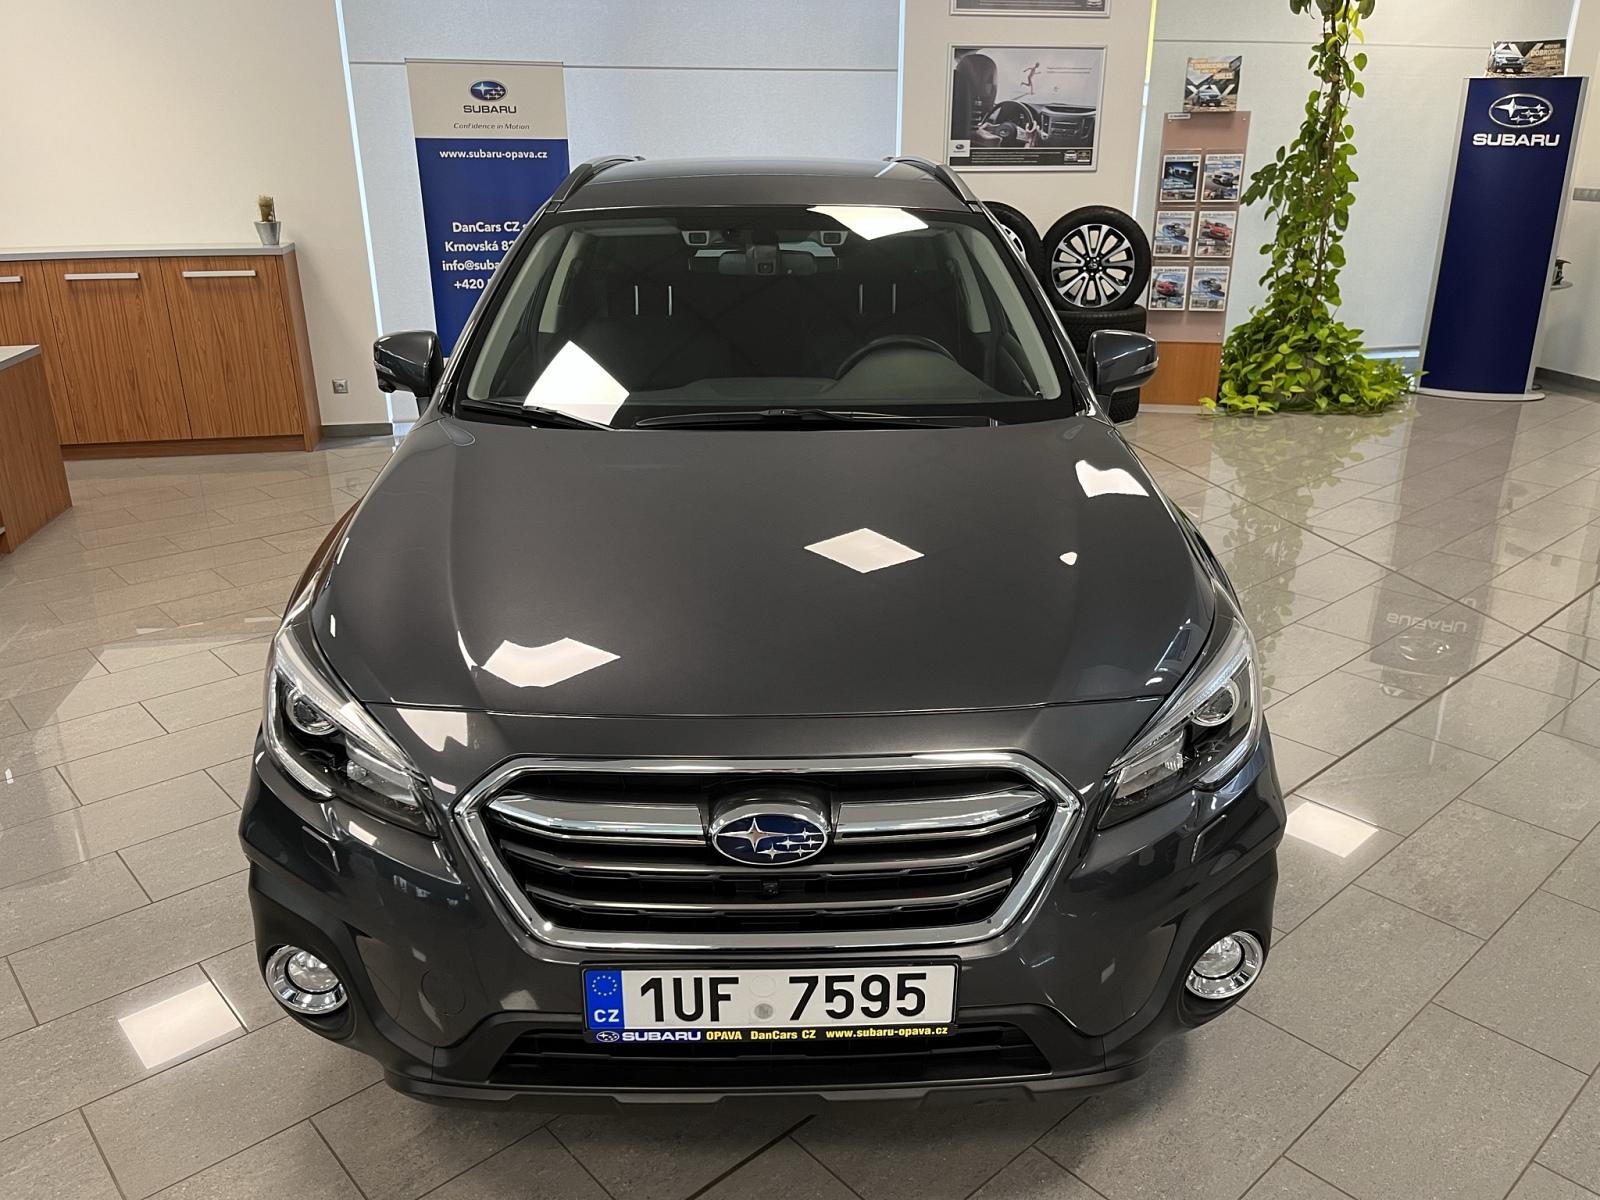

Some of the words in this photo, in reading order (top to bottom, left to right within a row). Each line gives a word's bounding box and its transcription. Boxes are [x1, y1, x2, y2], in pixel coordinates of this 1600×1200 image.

[463, 105, 517, 114] SUBARU
[453, 122, 496, 130] Confidence
[1472, 133, 1560, 146] SUBARU
[439, 149, 548, 160] www.subaru-opava.cz
[452, 222, 501, 233] DanCars
[503, 221, 520, 232] CZ
[444, 240, 499, 252] Krnovská
[453, 278, 485, 289] +420
[640, 976, 740, 1022] 1UF
[789, 972, 927, 1021] 7595
[593, 1009, 620, 1023] CZ
[622, 1031, 702, 1041] SUBARU
[706, 1030, 742, 1040] OPAVA
[750, 1030, 798, 1040] DanCars
[801, 1029, 816, 1039] CZ
[825, 1027, 948, 1038] www.subaru-opava.cz
